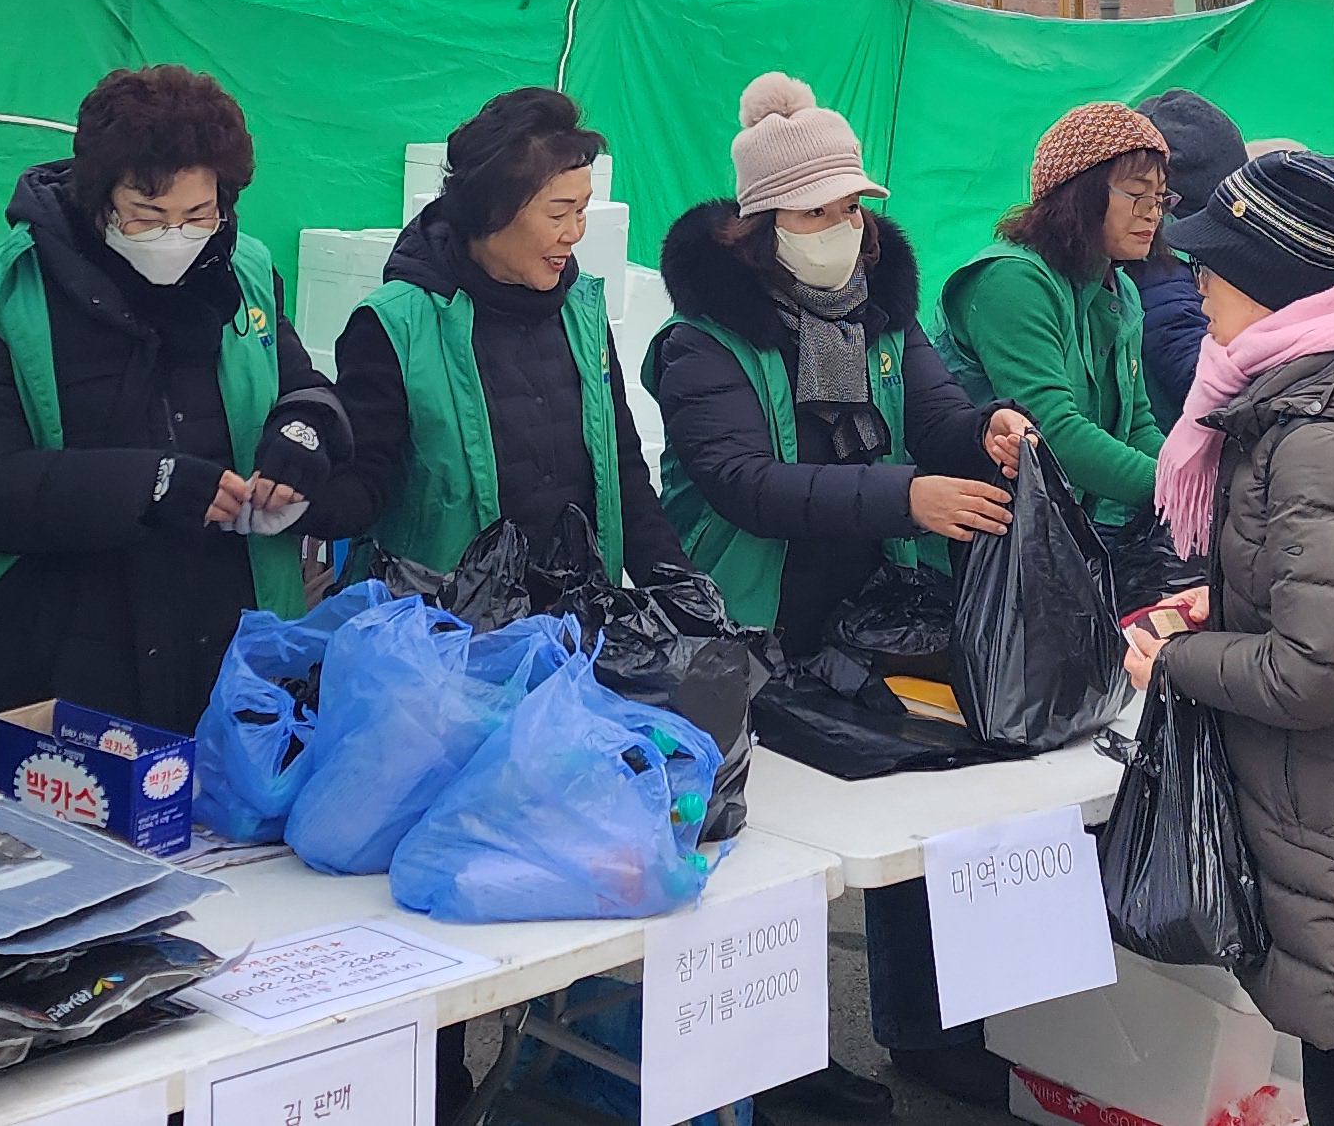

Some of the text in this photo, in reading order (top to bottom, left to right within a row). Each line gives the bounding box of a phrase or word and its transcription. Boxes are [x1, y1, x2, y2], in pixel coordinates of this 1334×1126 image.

[104, 737, 133, 757] 박카스
[25, 770, 97, 819] 박카스
[148, 765, 183, 786] 박카스
[951, 842, 1073, 904] 미역:9000
[252, 950, 358, 979] 새마을금고
[675, 918, 800, 983] 참기름:10000
[674, 968, 800, 1036] 들기름:22000
[283, 1083, 352, 1126] 김 판매
